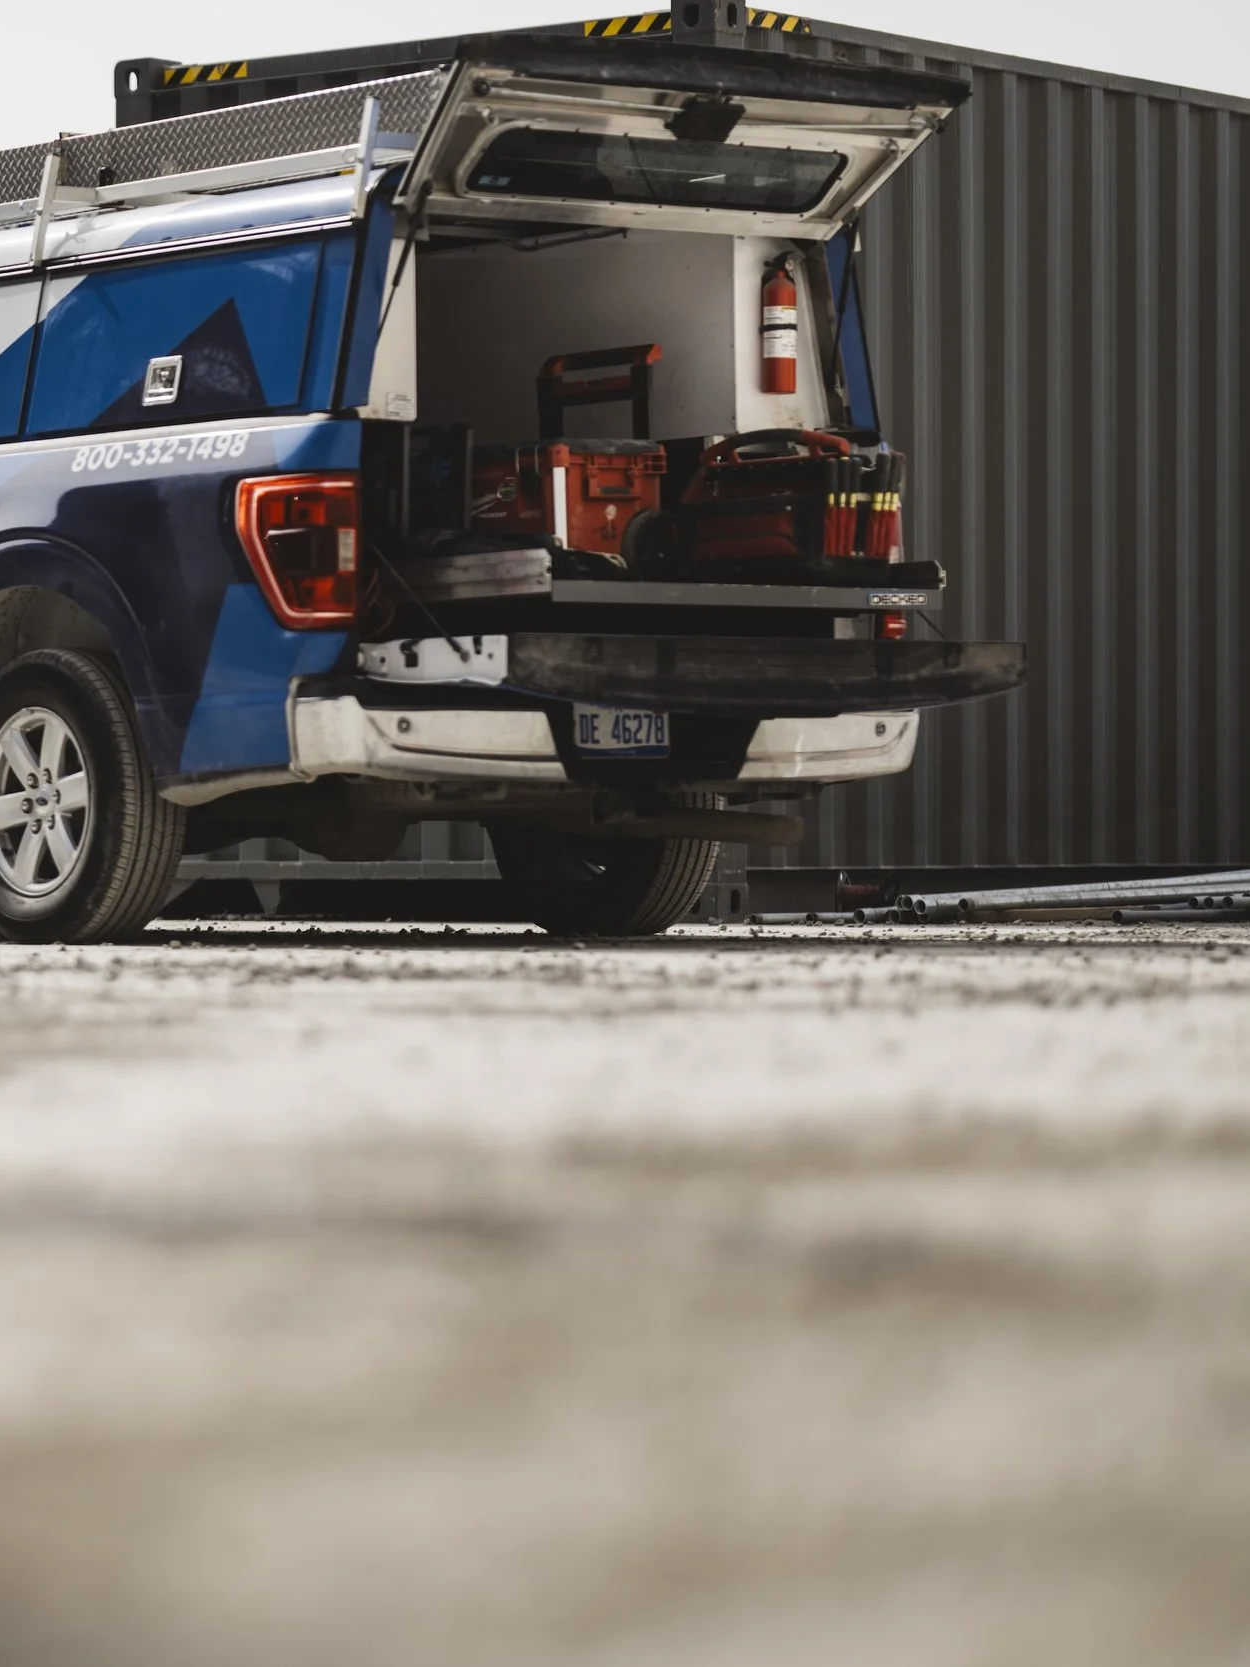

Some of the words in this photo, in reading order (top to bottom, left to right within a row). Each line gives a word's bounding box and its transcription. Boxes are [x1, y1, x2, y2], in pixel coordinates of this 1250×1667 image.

[71, 433, 249, 472] 800-332-1498
[871, 594, 927, 605] DECKED
[579, 714, 600, 744] DE
[612, 714, 665, 744] 46278
